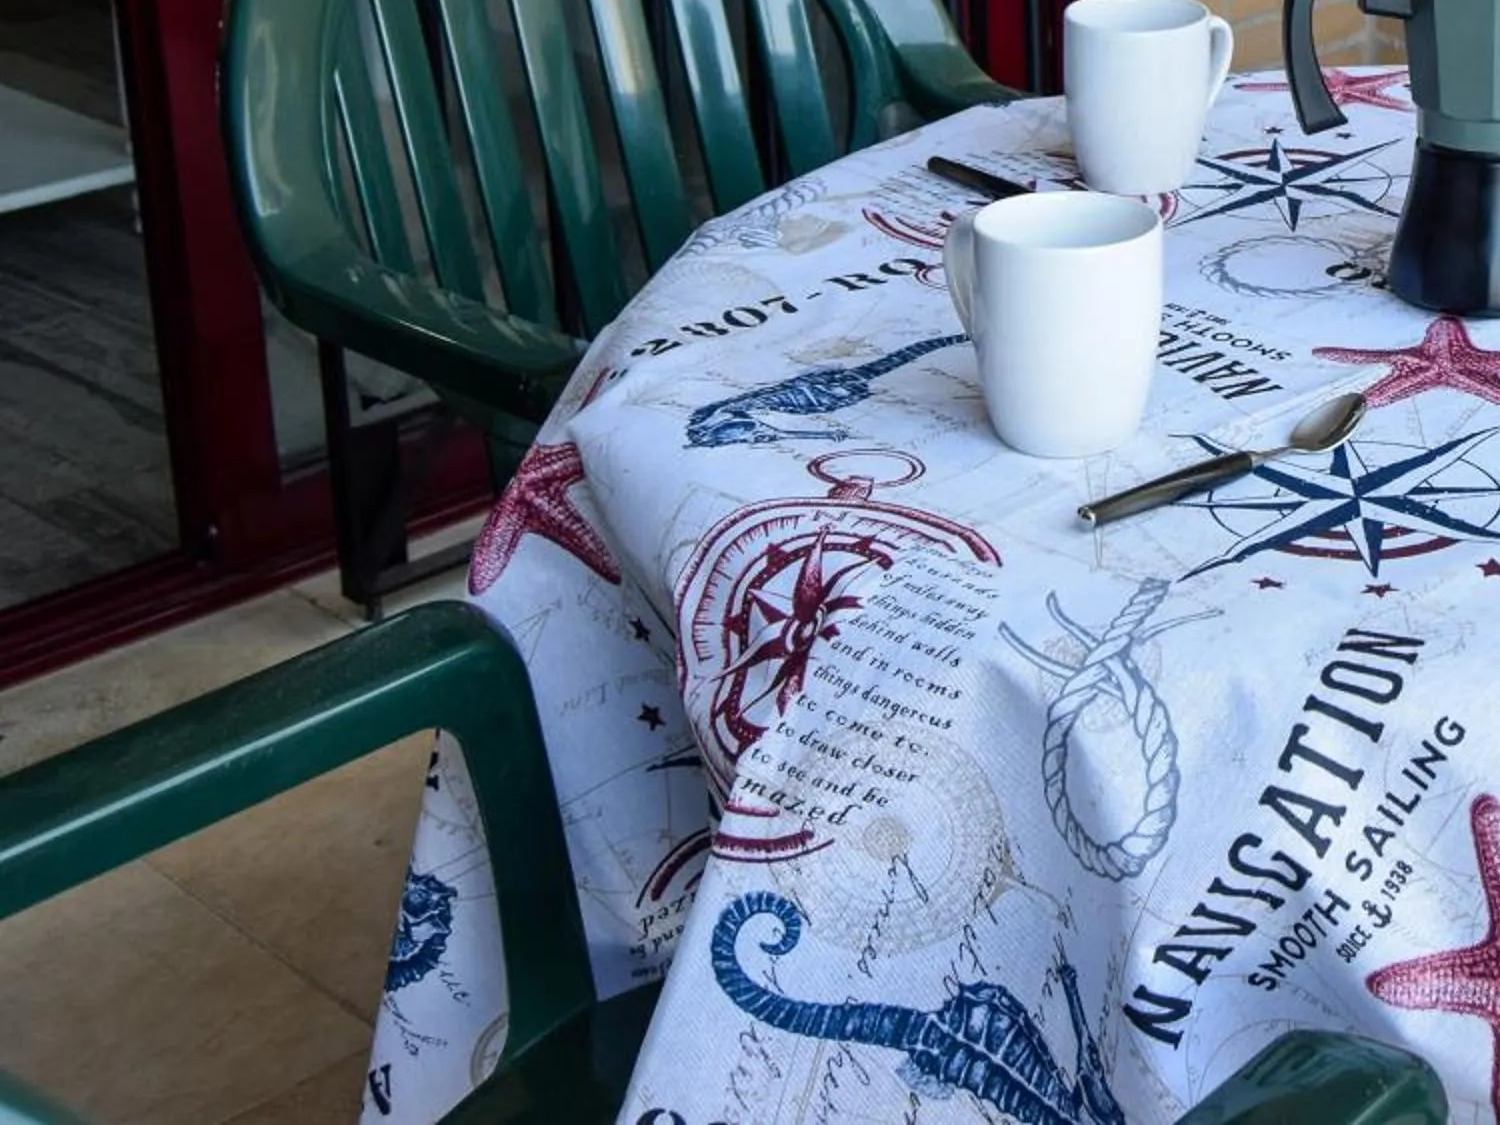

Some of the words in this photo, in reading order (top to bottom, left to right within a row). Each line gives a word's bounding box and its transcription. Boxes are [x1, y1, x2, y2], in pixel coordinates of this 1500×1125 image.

[830, 639, 873, 663] and
[868, 652, 890, 673] in
[812, 663, 859, 701] things
[775, 720, 796, 739] to
[798, 728, 848, 761] draw
[850, 753, 922, 785] closer
[777, 760, 808, 782] see
[811, 773, 859, 798] and
[861, 785, 890, 809] be
[1121, 627, 1426, 1051] NAVIGATION
[1247, 888, 1352, 993] SMOOTH
[1344, 714, 1467, 882] SAILING
[1382, 859, 1414, 903] 1938
